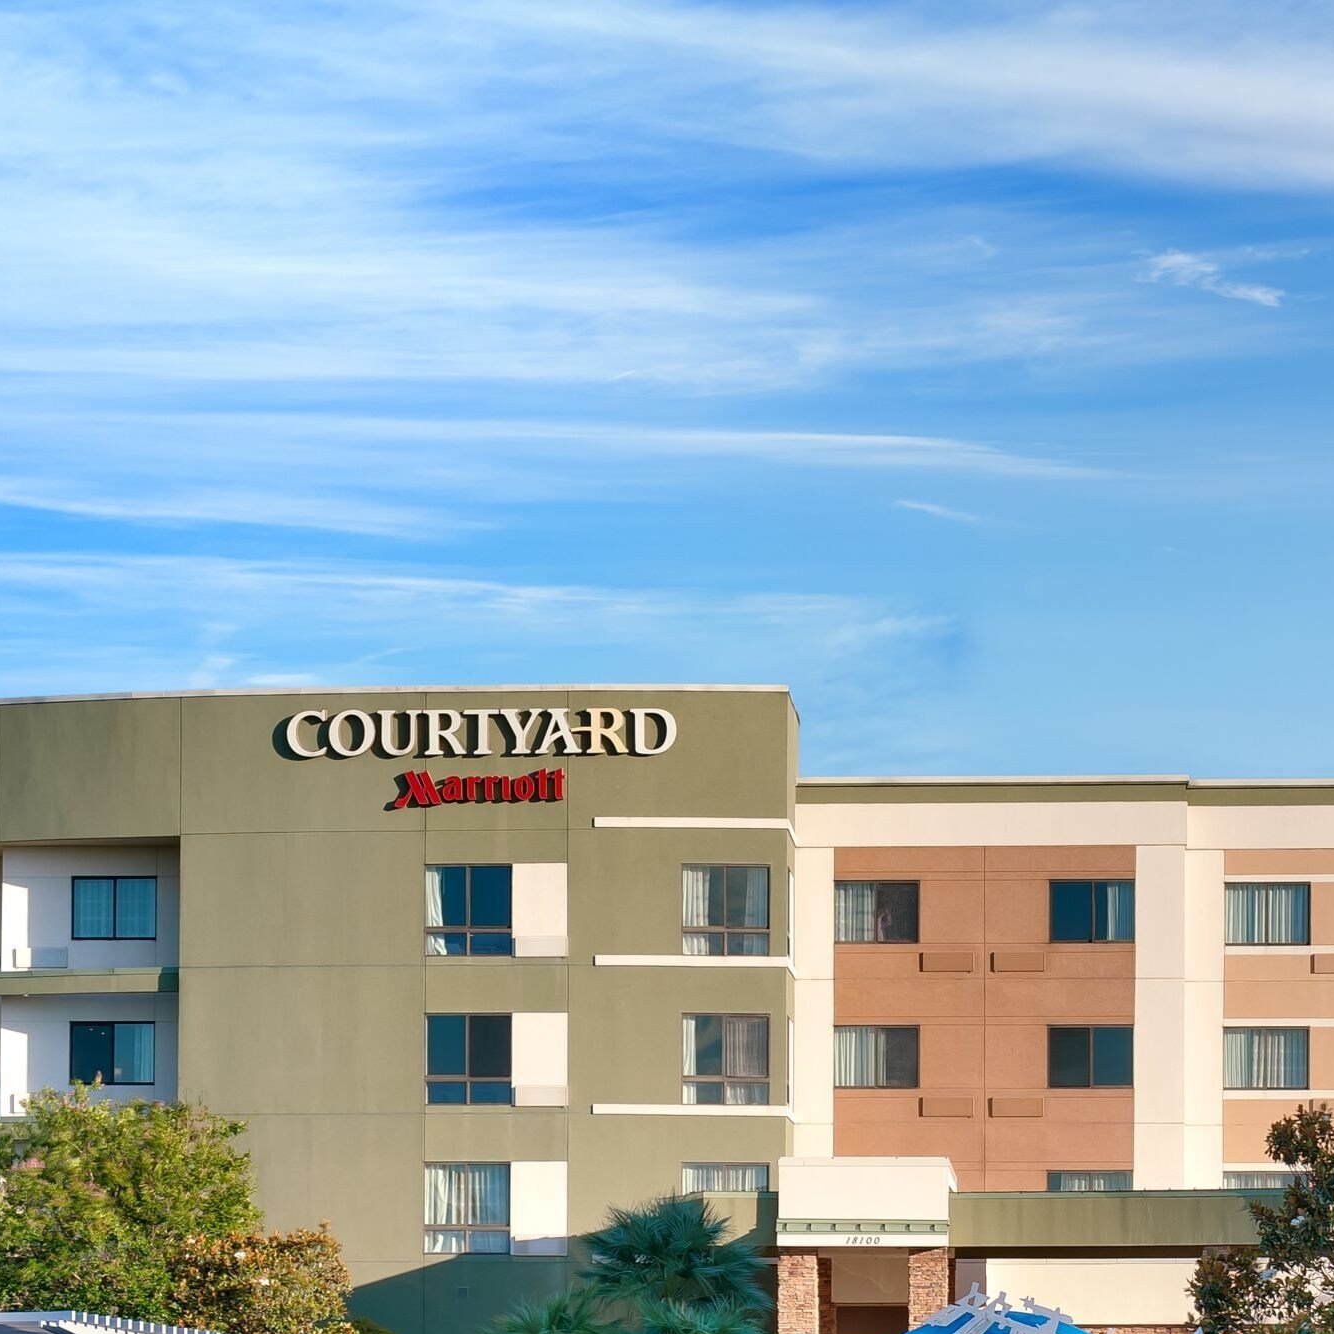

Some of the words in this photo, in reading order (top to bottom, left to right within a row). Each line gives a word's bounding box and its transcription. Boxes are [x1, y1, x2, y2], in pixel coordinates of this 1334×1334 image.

[285, 707, 678, 758] COURTYARD
[393, 767, 566, 809] Marriott
[845, 1236, 881, 1245] 18100
